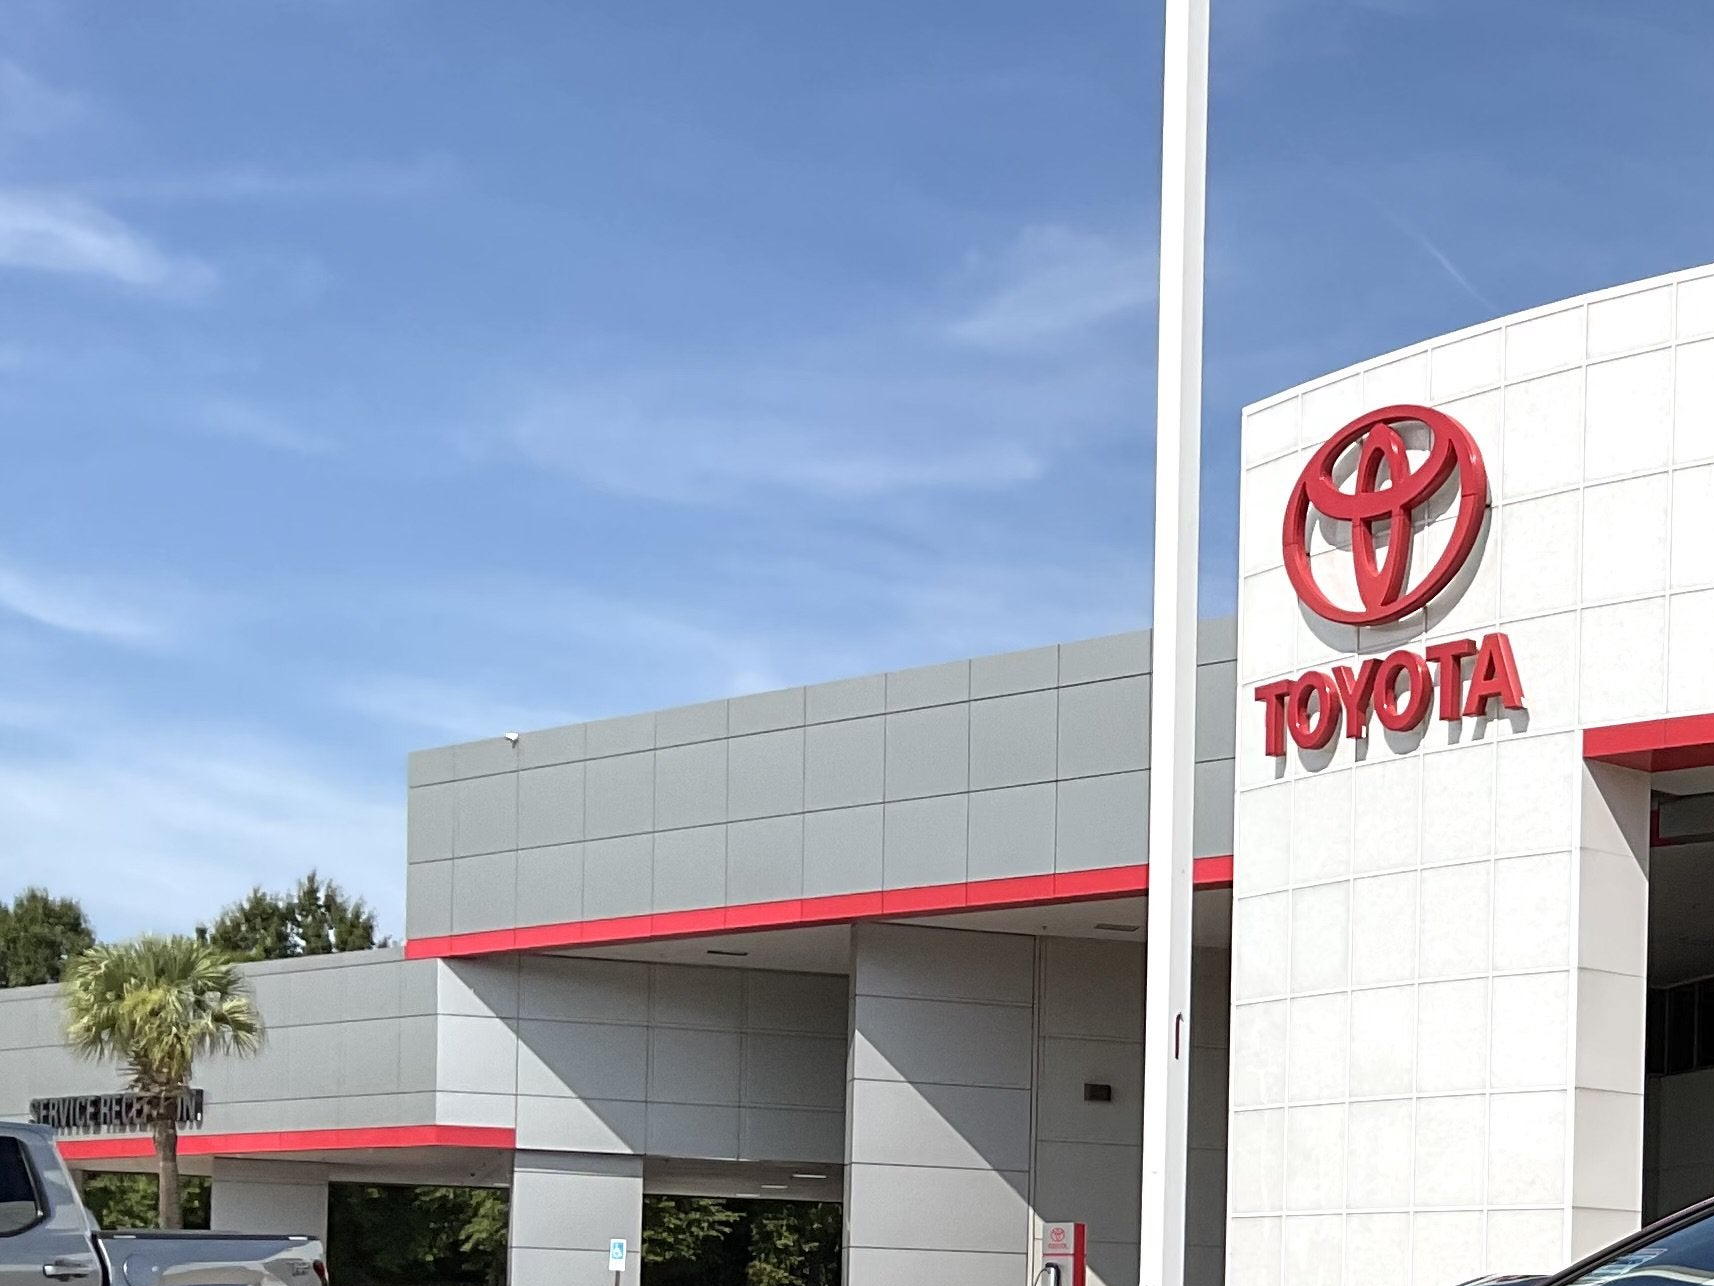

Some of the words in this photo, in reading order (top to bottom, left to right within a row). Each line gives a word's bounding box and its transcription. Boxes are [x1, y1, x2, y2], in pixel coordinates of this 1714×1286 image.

[1255, 632, 1525, 757] TOYOTA
[29, 1096, 98, 1128] SERVICE
[100, 1090, 202, 1126] RECEPN
